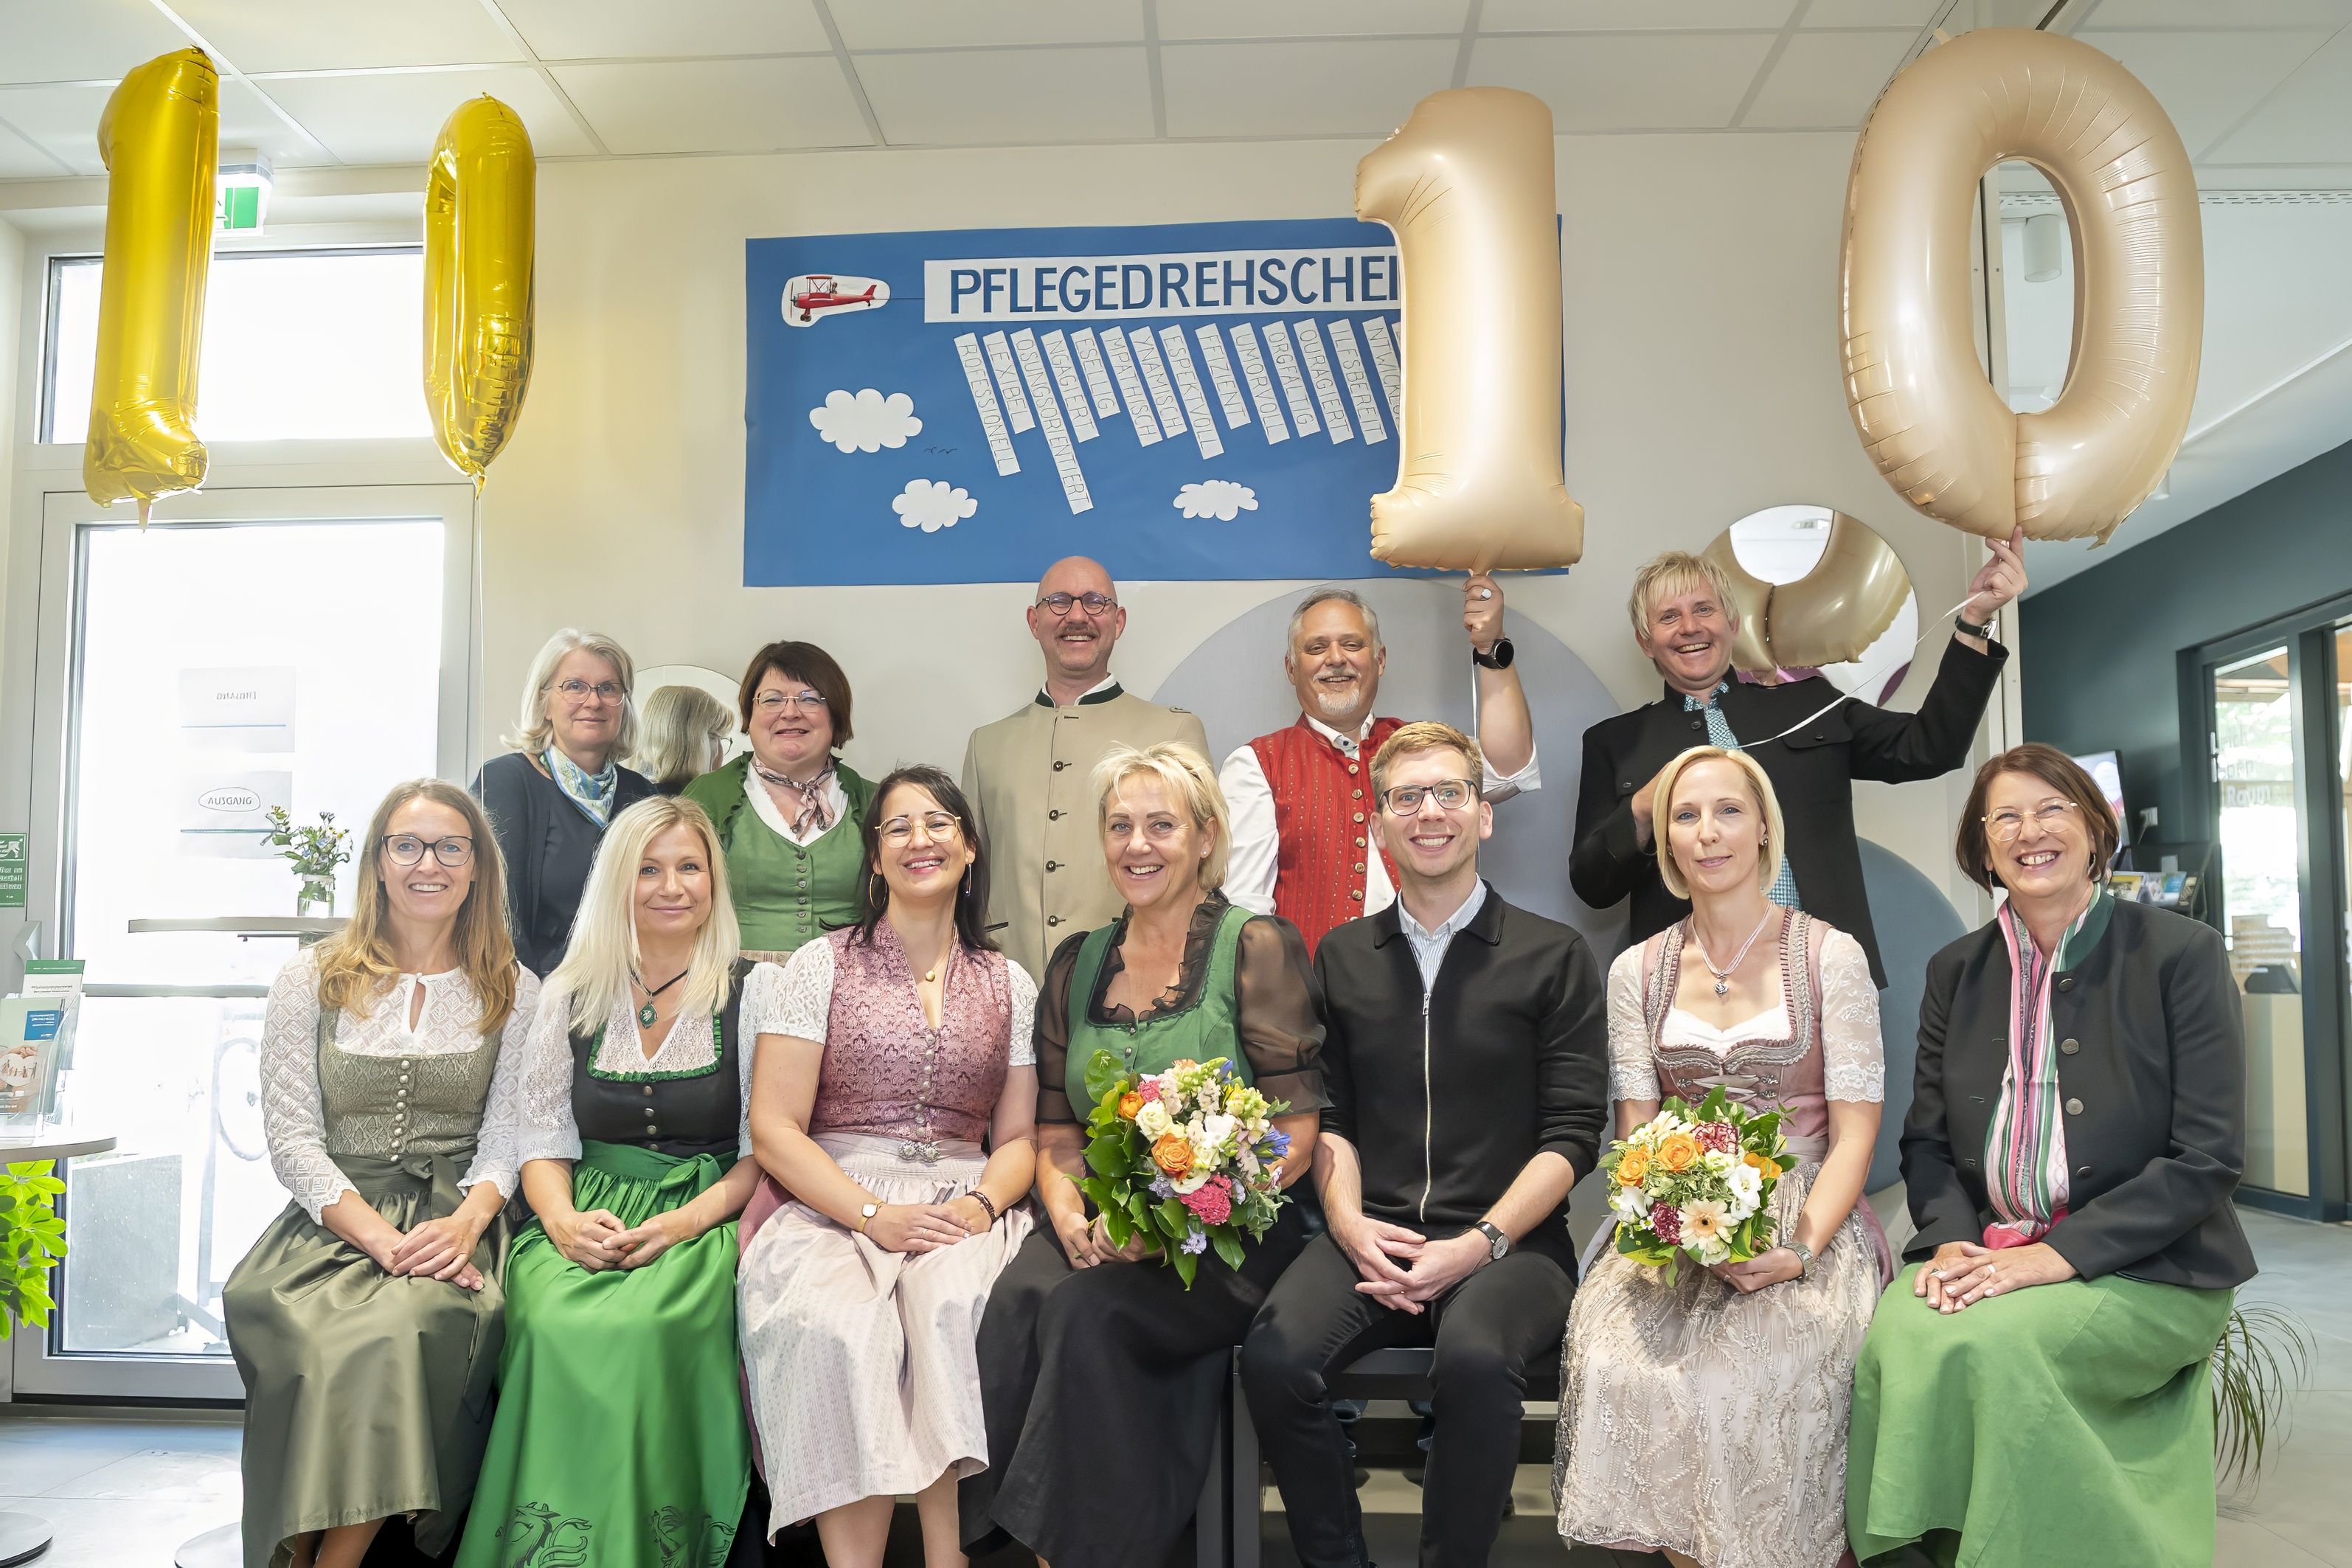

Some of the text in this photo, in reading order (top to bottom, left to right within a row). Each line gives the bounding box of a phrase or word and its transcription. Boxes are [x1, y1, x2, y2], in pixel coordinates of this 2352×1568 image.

[950, 255, 1398, 315] PFLEGEDREHSCHEI
[959, 344, 1014, 468] ROFESSIONELL
[986, 341, 1027, 425] LEXIBEL
[1045, 340, 1095, 429] NGAGIERT
[1075, 338, 1115, 410] ESELLIG
[1105, 336, 1157, 437] MPATHISCH
[1134, 336, 1183, 429] YNAMISCH
[1164, 335, 1217, 451] ESPEKTVOLL
[1199, 334, 1246, 417] FFIZIENT
[1235, 333, 1284, 437] UMORVOLL
[1299, 329, 1350, 433] OURAGIERT
[1331, 330, 1383, 435] ILFSBEREIT
